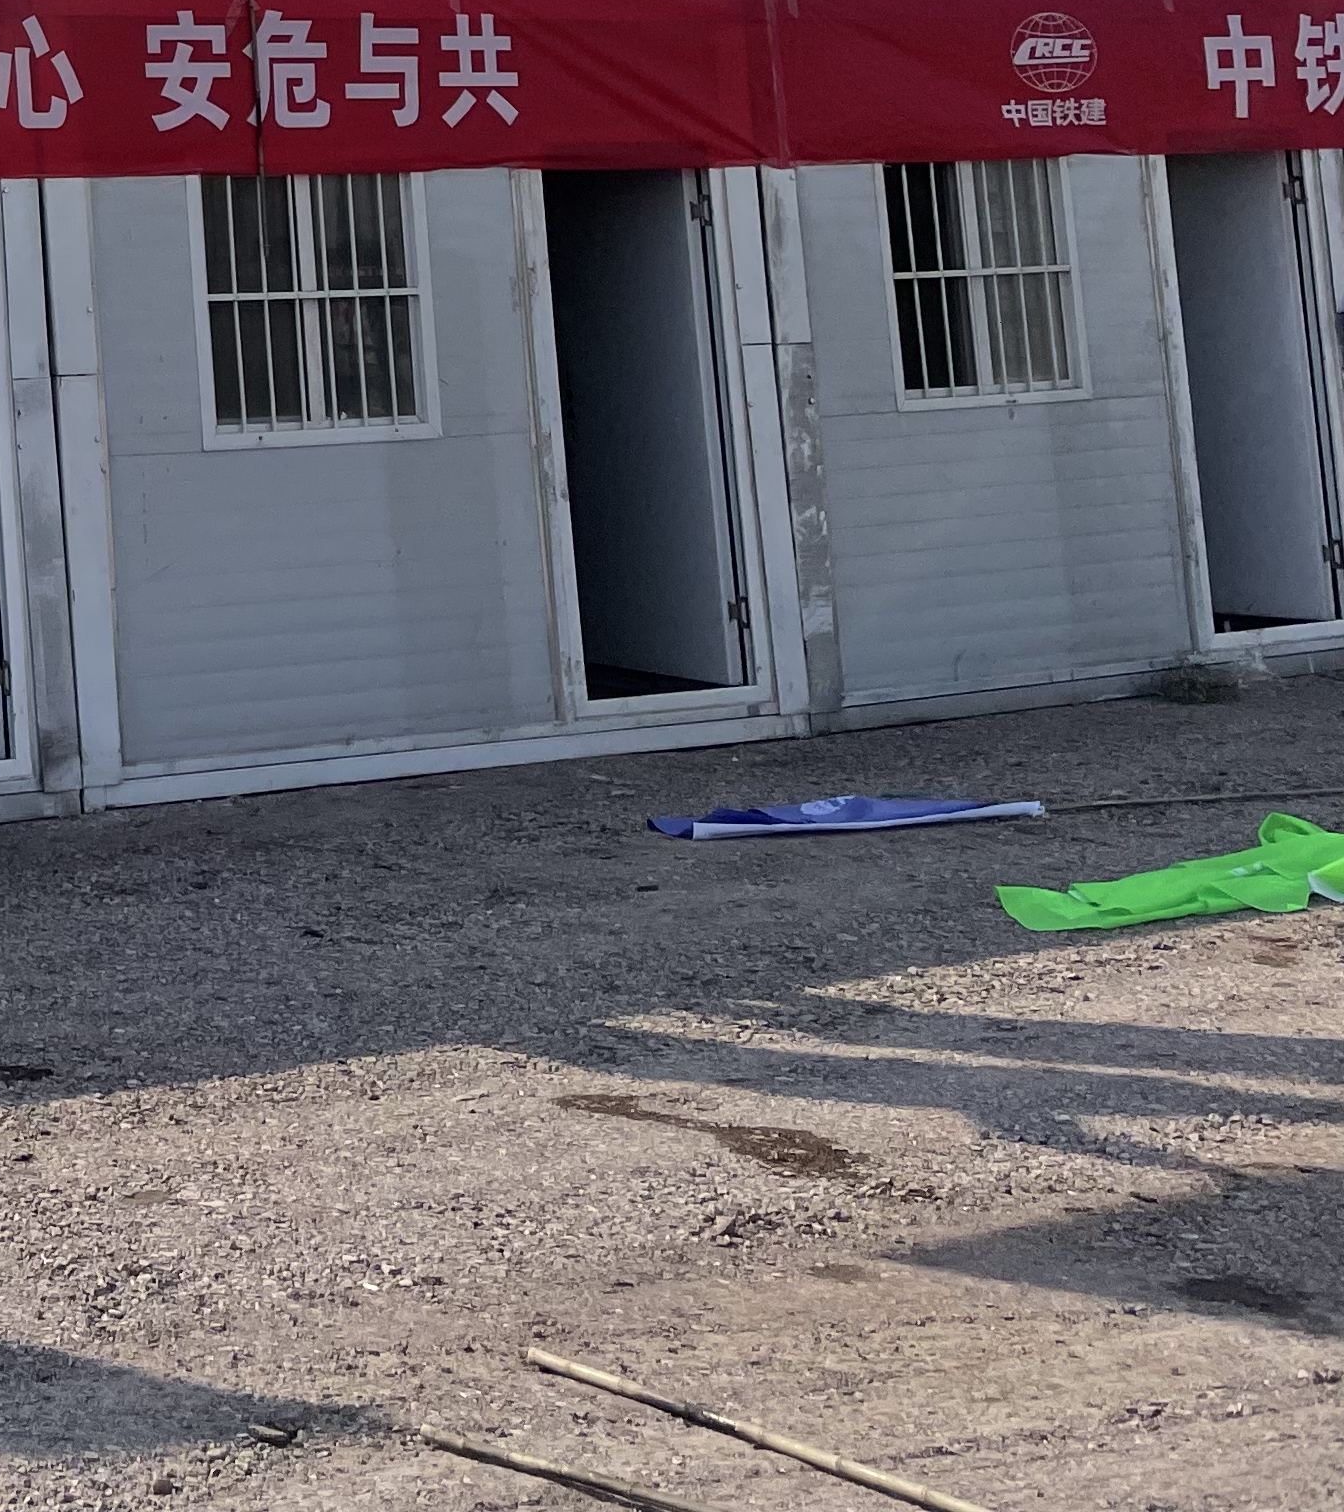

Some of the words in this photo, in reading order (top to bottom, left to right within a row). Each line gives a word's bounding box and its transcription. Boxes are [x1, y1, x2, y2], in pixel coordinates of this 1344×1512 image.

[1013, 37, 1092, 65] CRCC
[144, 10, 519, 131] 安危与共
[1001, 98, 1107, 128] 中国铁建
